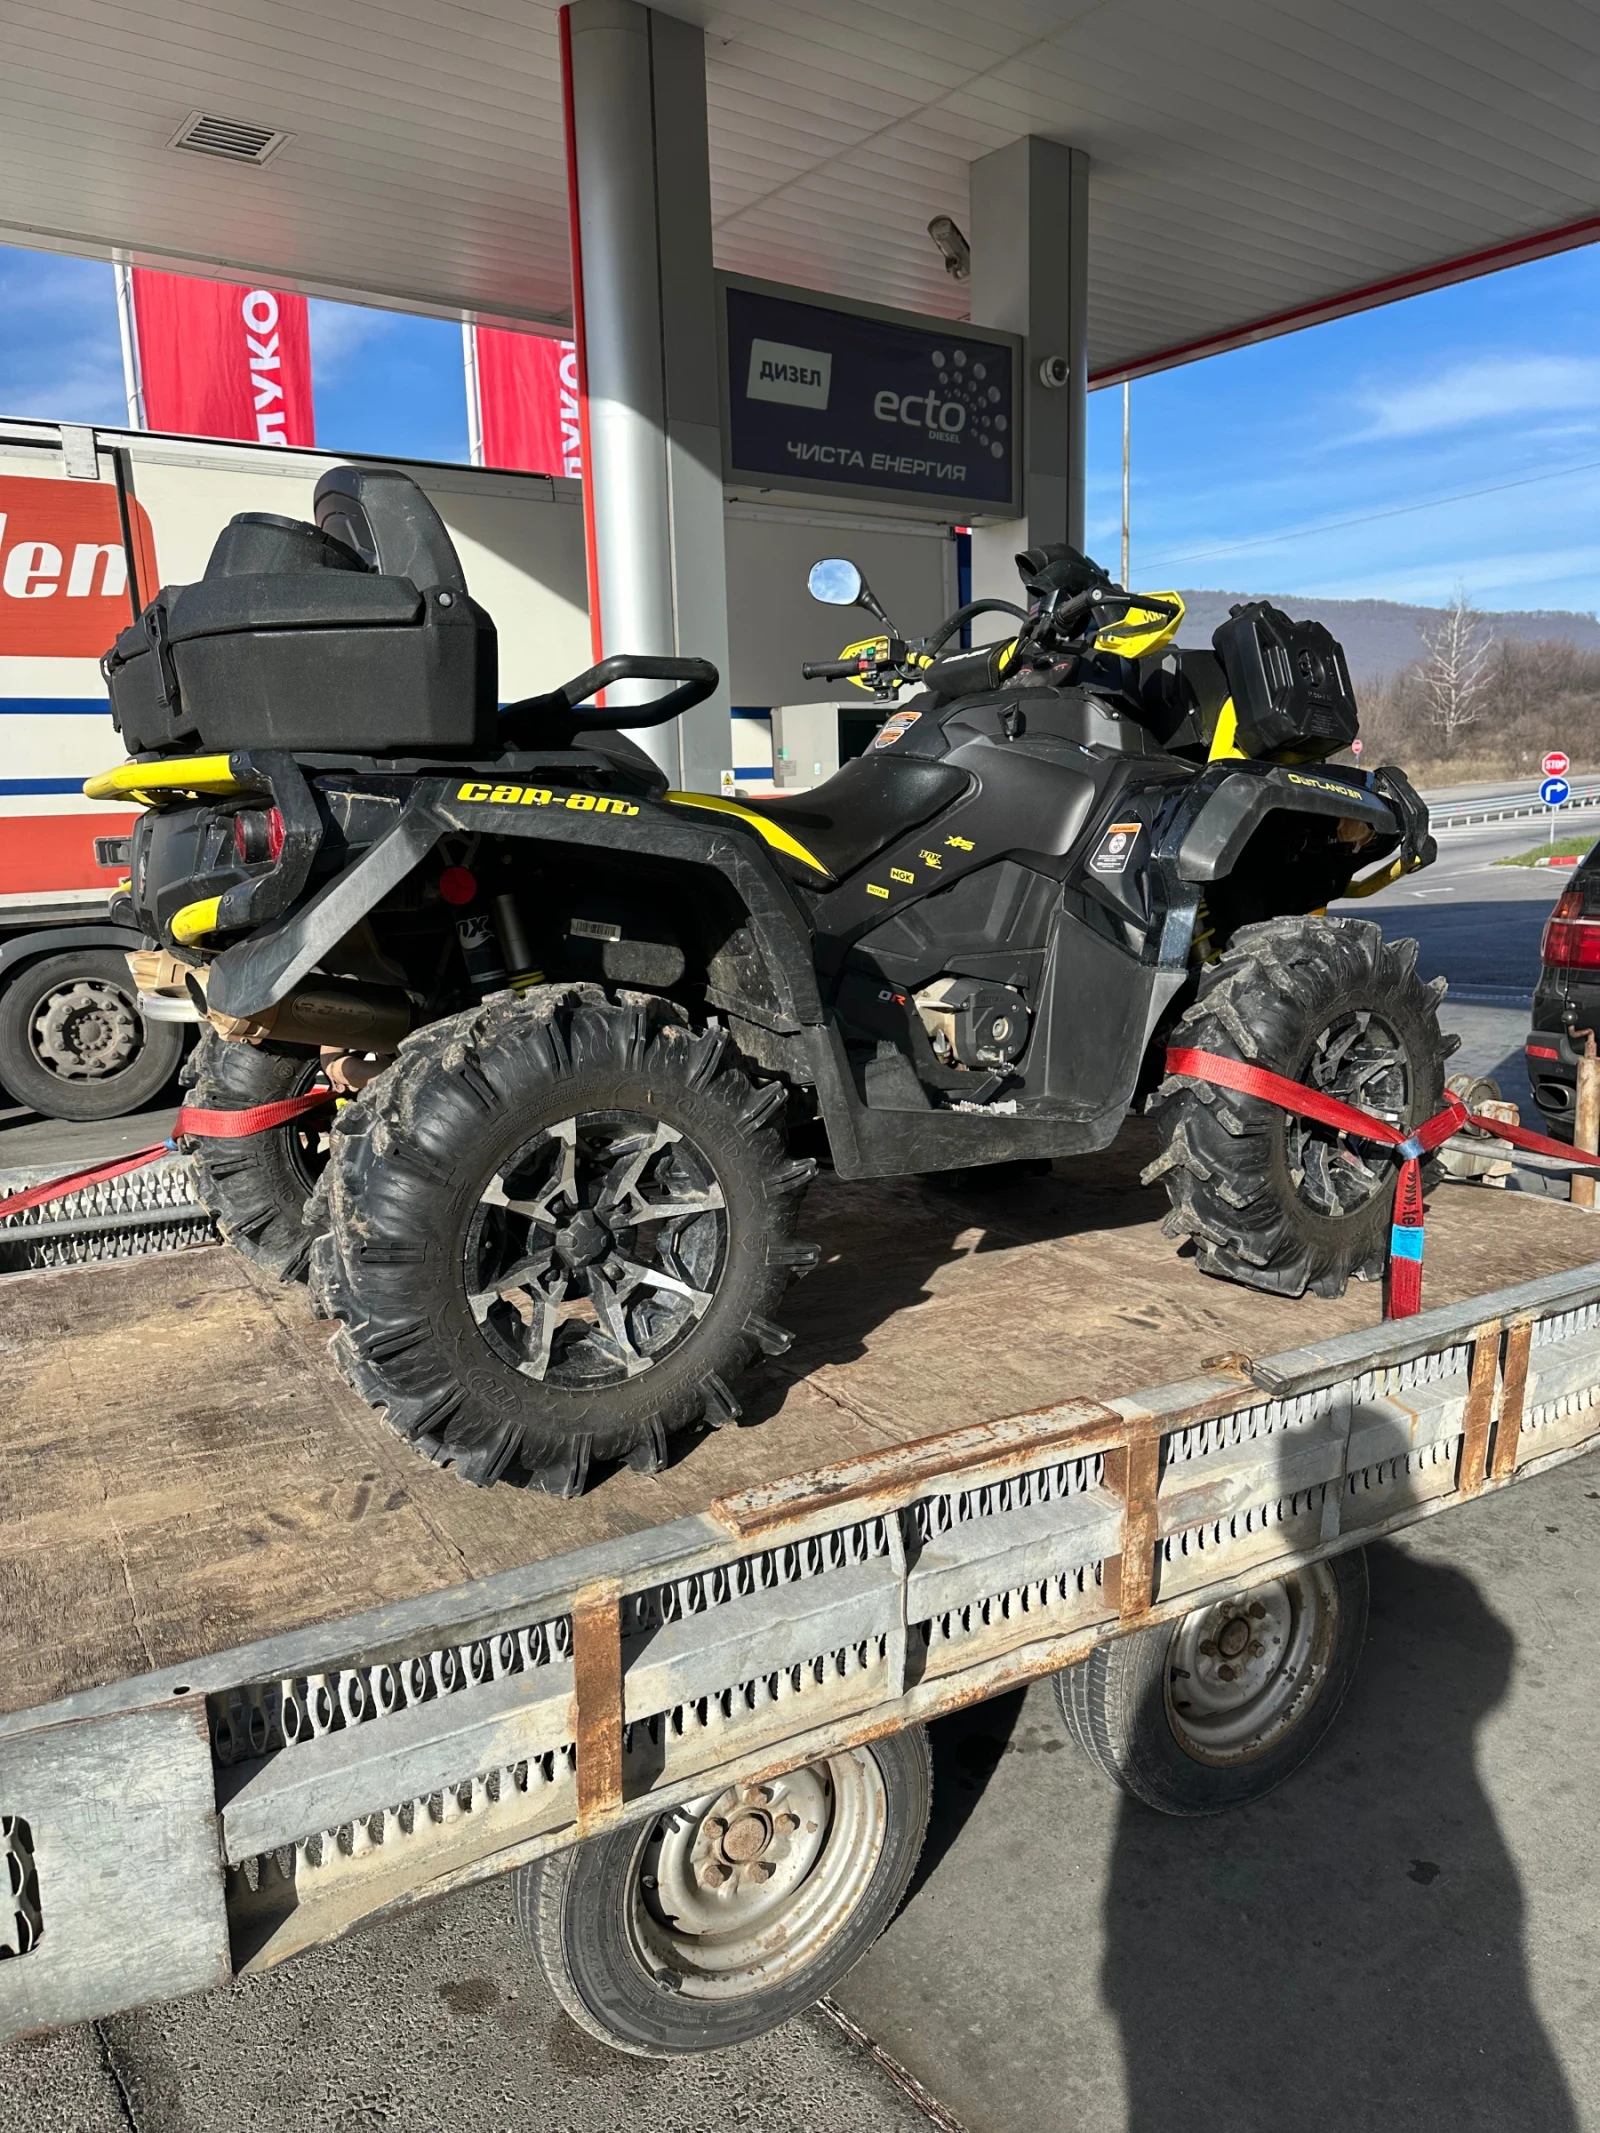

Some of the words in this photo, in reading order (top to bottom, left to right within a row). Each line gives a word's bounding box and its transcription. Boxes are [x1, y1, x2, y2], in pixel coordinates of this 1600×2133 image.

[759, 360, 822, 387] ДИЗЕЛ
[873, 389, 966, 432] ecto
[928, 430, 961, 444] DIESEL
[787, 440, 865, 468] ЧИСТА
[870, 452, 967, 481] ЕНЕРГИЯ
[1545, 759, 1567, 770] STOP
[891, 869, 912, 881] NGK
